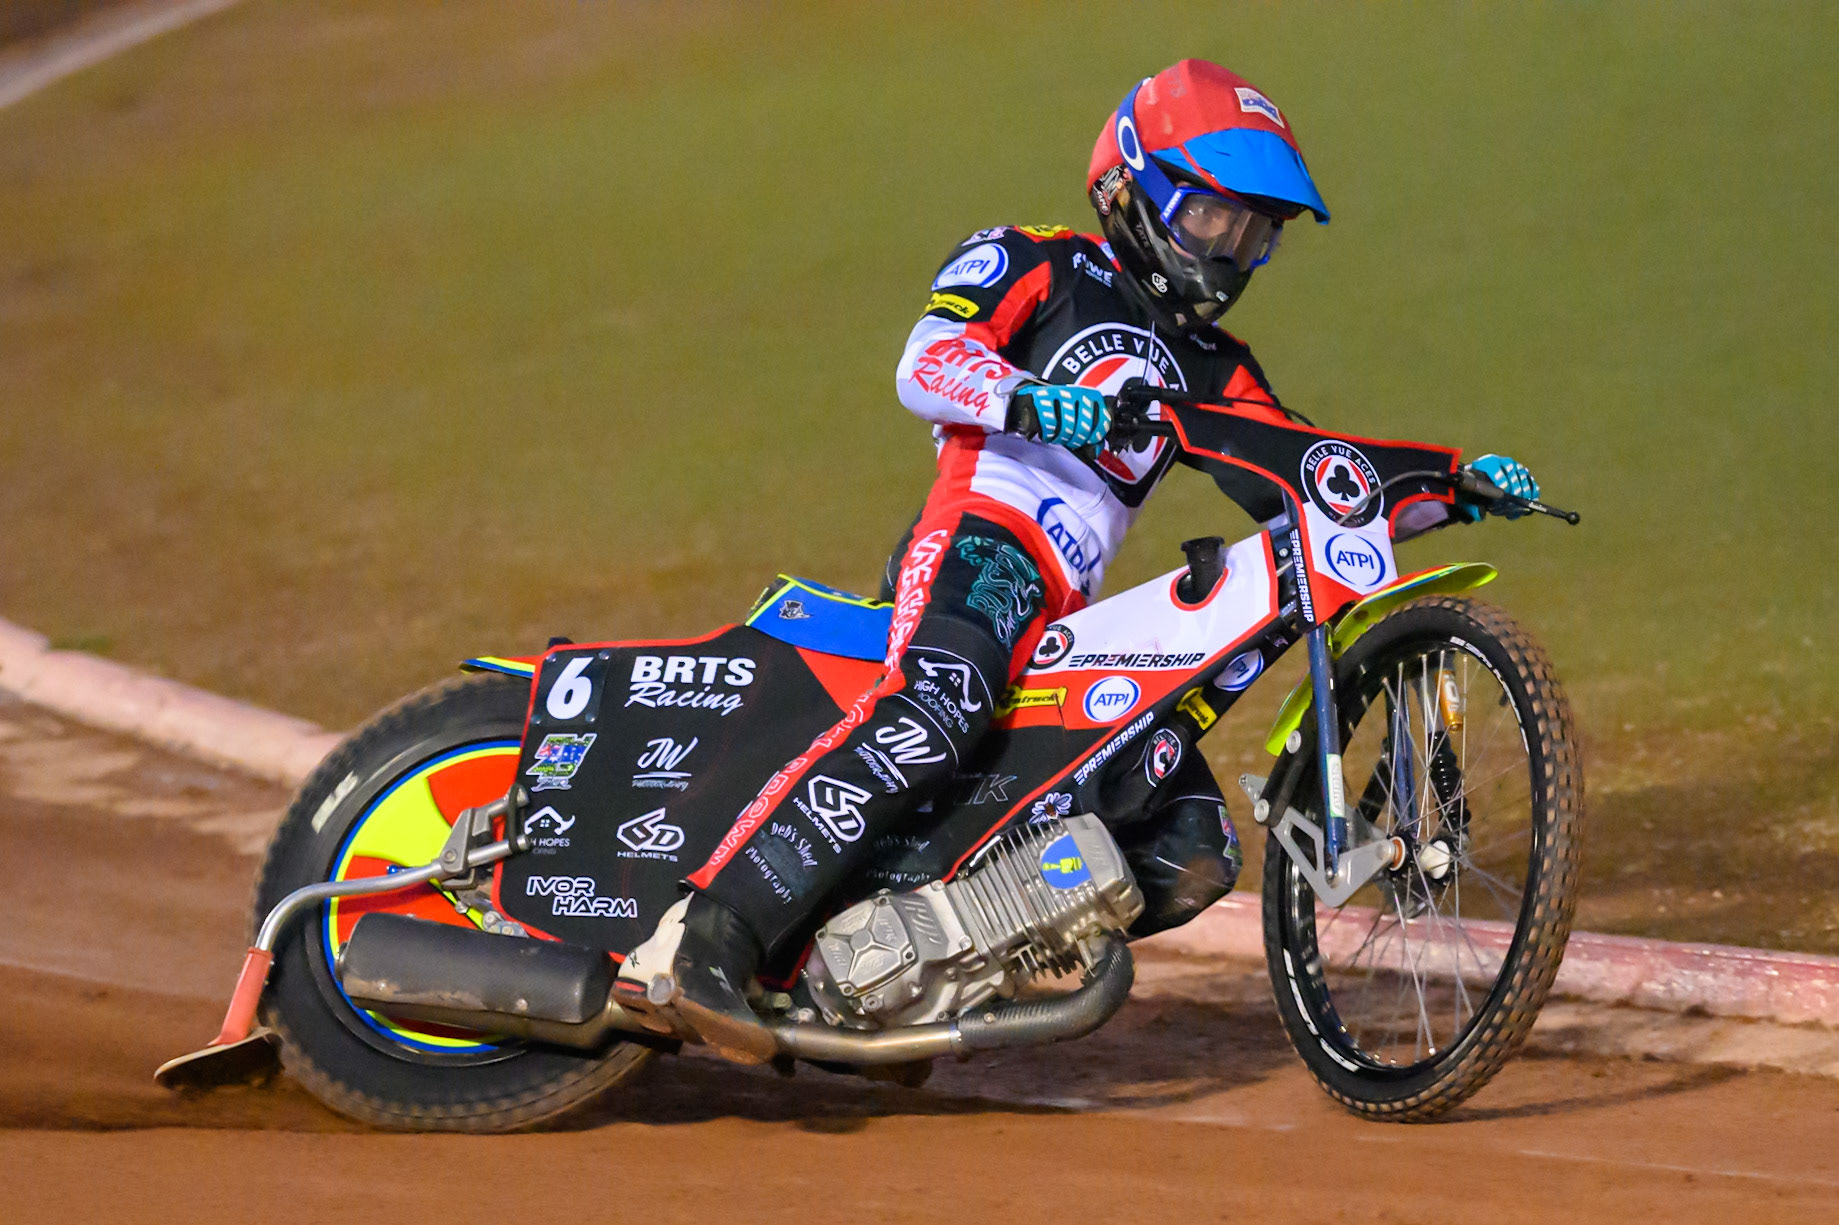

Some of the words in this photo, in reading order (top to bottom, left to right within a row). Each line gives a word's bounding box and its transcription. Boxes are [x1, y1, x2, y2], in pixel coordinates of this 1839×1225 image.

[949, 259, 990, 276] ATPI
[1061, 333, 1125, 375] BELLE
[1133, 337, 1170, 375] VUE
[908, 356, 991, 417] Racing
[1306, 446, 1329, 472] BELLE
[1331, 445, 1352, 458] VUE
[1354, 457, 1377, 485] ACES
[1289, 528, 1315, 624] PREMIERSHIP
[1336, 550, 1375, 570] ATPI
[630, 655, 757, 687] BRTS
[1069, 652, 1206, 668] PREMIERSHIP
[546, 656, 594, 720] 6
[624, 681, 744, 717] Racing
[1093, 693, 1130, 707] ATPI
[913, 680, 941, 696] HIGH
[939, 692, 970, 734] HOPES
[636, 736, 699, 771] JW
[875, 716, 948, 764] JW
[1072, 711, 1155, 786] PREMIERSHIP
[538, 838, 571, 848] HOPES
[793, 796, 842, 855] HELMETS
[617, 851, 679, 862] HELMETS
[793, 837, 819, 868] Shed
[526, 876, 596, 897] IVOR
[745, 845, 793, 905] Photography
[552, 896, 638, 918] HARM
